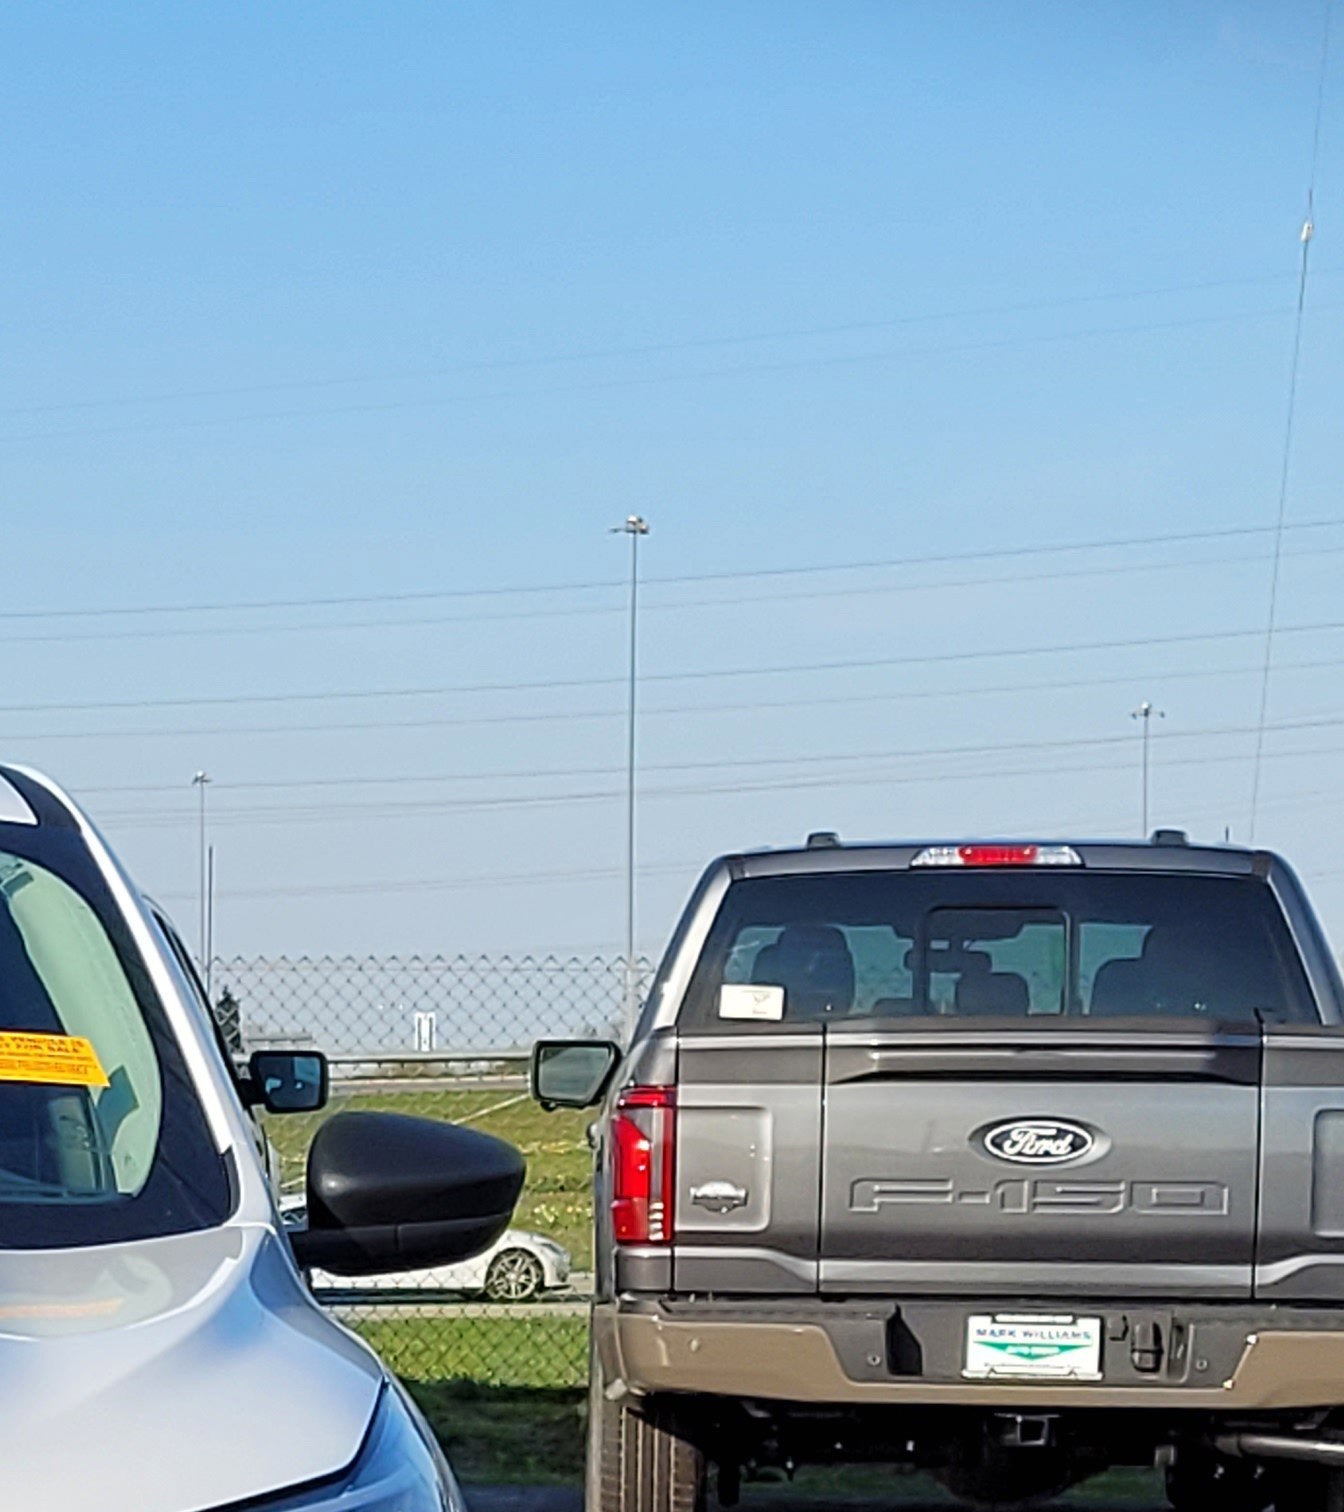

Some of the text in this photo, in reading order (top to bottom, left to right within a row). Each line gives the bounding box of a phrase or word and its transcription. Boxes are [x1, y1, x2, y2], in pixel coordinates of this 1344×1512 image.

[1002, 1126, 1074, 1157] Ford
[847, 1178, 1229, 1216] F-150
[975, 1328, 1092, 1340] MARK WILLIAMS
